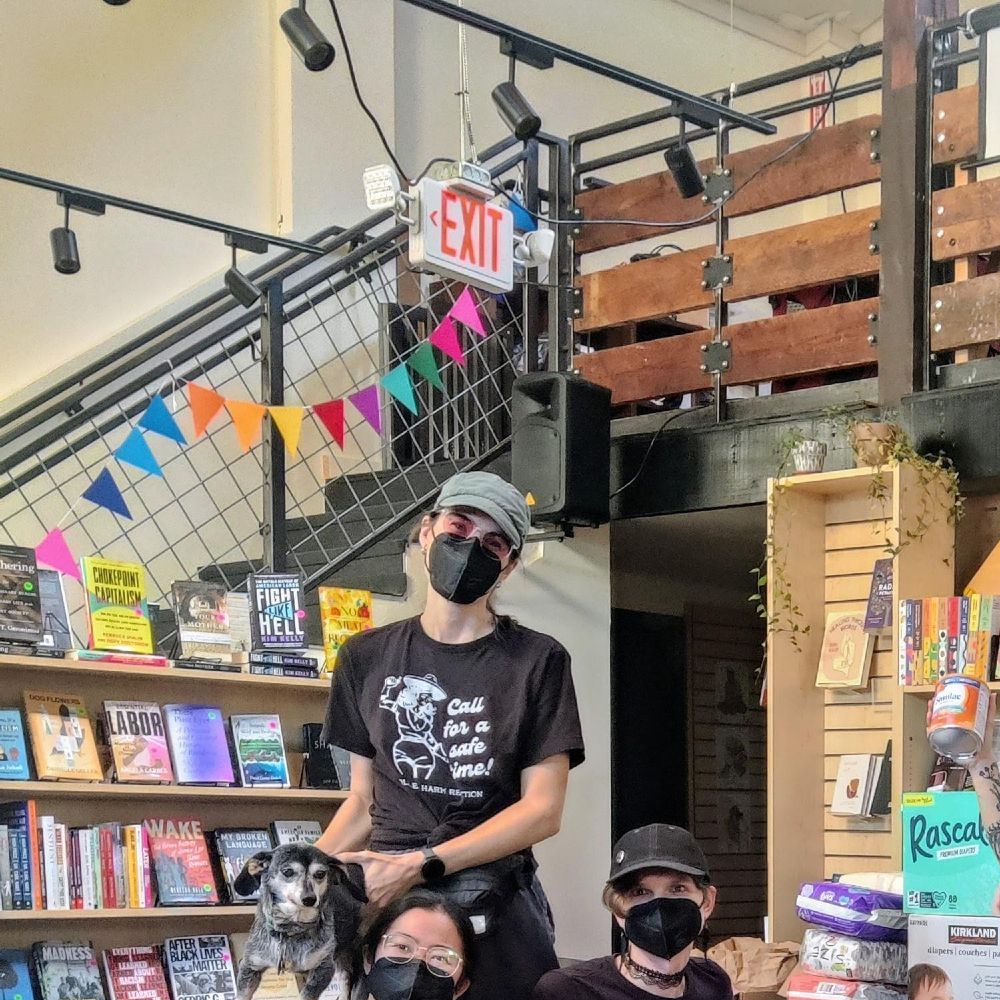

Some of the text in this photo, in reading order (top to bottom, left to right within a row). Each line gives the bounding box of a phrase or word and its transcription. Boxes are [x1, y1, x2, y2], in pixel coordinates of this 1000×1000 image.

[440, 189, 503, 273] EXIT
[93, 566, 140, 588] CHOKEPOINT
[95, 586, 142, 606] CAPITALISM
[256, 588, 300, 613] FIGHT
[268, 603, 290, 618] LIKE
[341, 606, 357, 616] NO
[259, 612, 304, 635] HELL
[280, 635, 304, 643] KELLY
[447, 697, 484, 716] Call
[107, 711, 163, 735] LABOR
[443, 719, 490, 738] for a
[449, 737, 486, 758] safe
[144, 819, 201, 839] WAKE
[221, 832, 268, 841] MY BROKEN
[226, 841, 268, 849] LANGUAGE
[910, 814, 989, 864] Rascal
[950, 927, 997, 938] KIRKLAND
[169, 938, 196, 950] AFTER
[927, 946, 954, 956] diapers
[958, 949, 987, 957] couches
[42, 946, 93, 960] MADNESS
[171, 948, 224, 962] BLACK LIVES
[192, 960, 227, 971] MATTER
